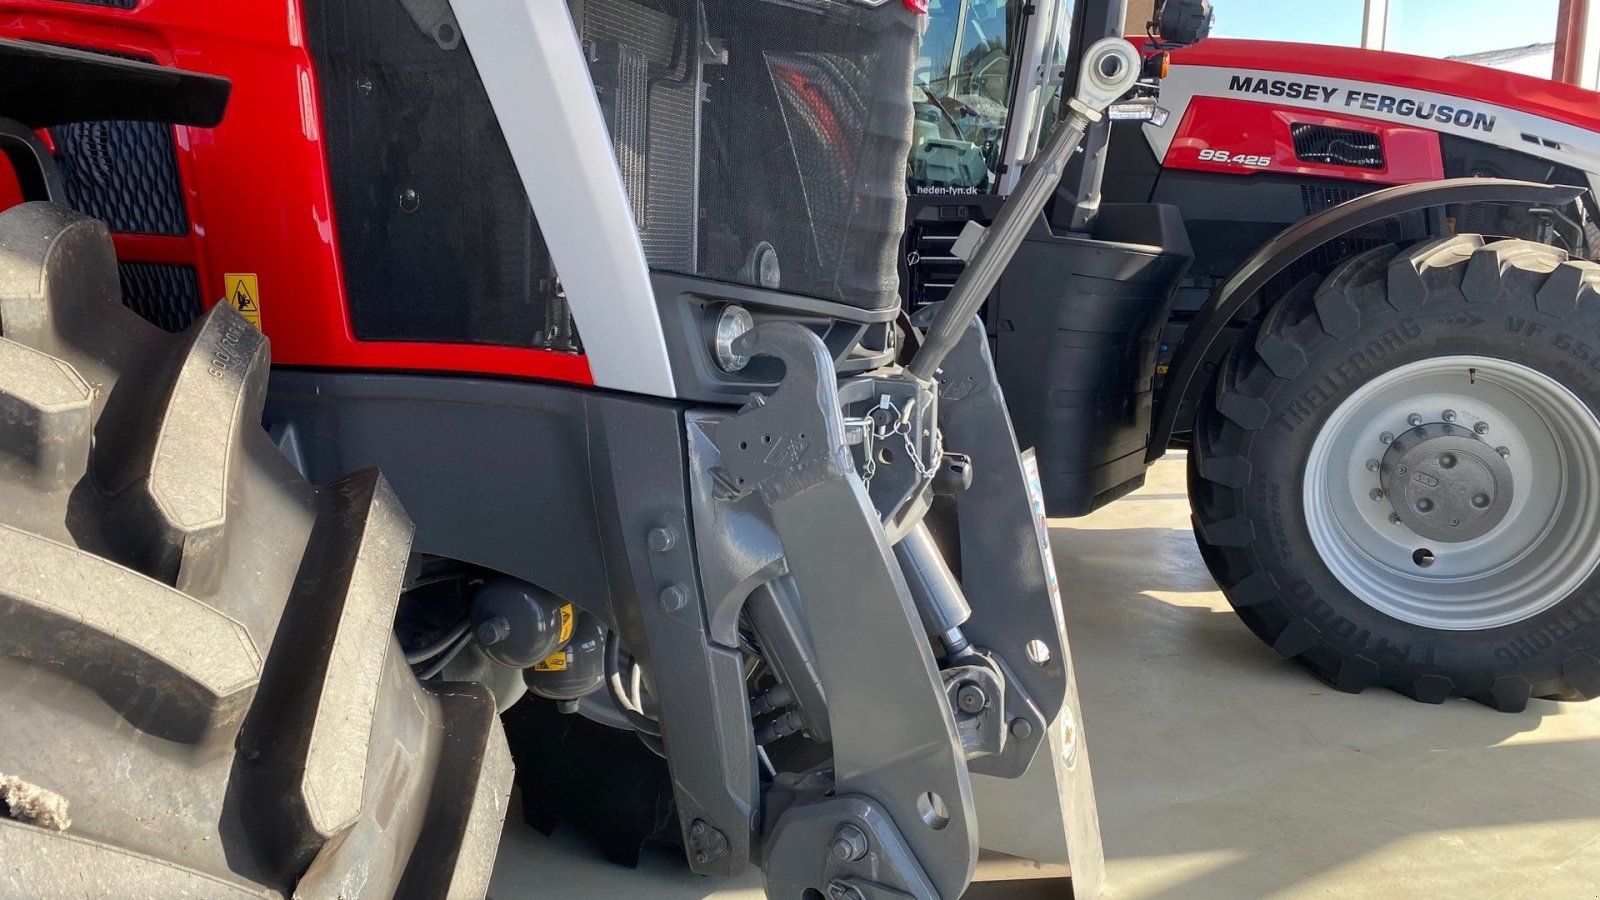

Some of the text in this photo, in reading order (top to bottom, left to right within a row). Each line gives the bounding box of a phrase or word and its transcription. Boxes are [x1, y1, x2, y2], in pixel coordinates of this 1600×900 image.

[1228, 75, 1497, 132] MASSEY FERGUSON
[1197, 148, 1272, 167] 9S.425
[916, 185, 978, 196] heden-fyn.dk
[1504, 315, 1547, 337] VF
[1273, 316, 1424, 431] TRELLEBORG
